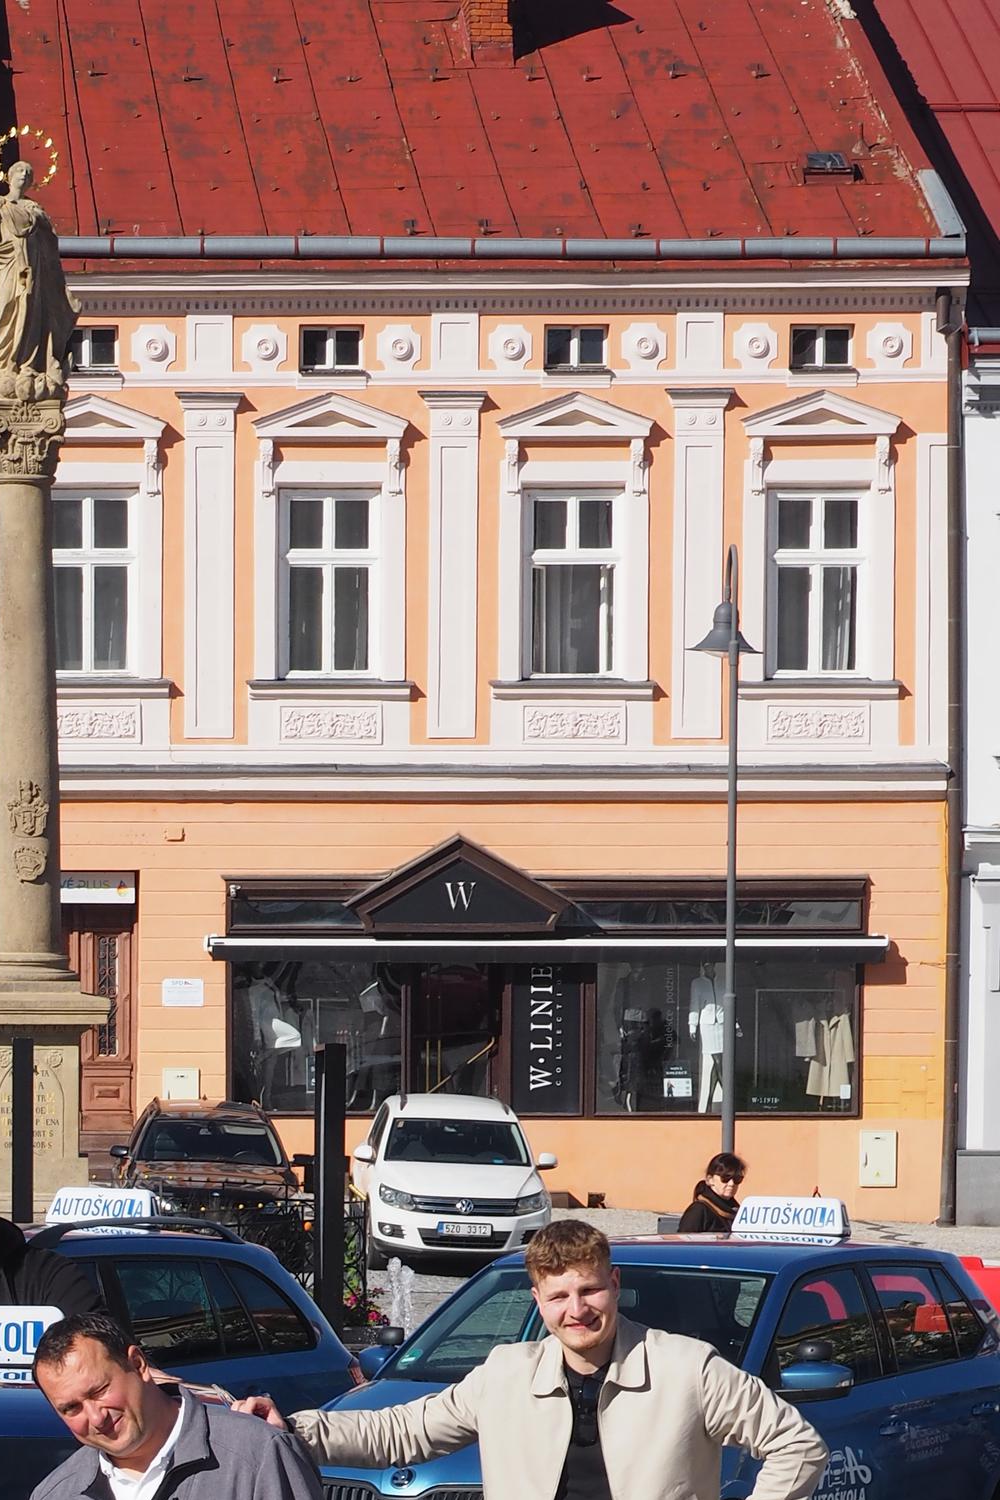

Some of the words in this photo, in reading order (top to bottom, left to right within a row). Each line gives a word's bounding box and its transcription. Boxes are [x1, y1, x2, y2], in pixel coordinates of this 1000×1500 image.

[445, 881, 476, 911] W
[666, 967, 675, 1004] podzim
[664, 1009, 673, 1049] kolekce
[52, 1194, 143, 1218] AUTOŠKOLA
[738, 1203, 836, 1228] AUTOŠKOLA
[467, 1225, 488, 1234] 3312
